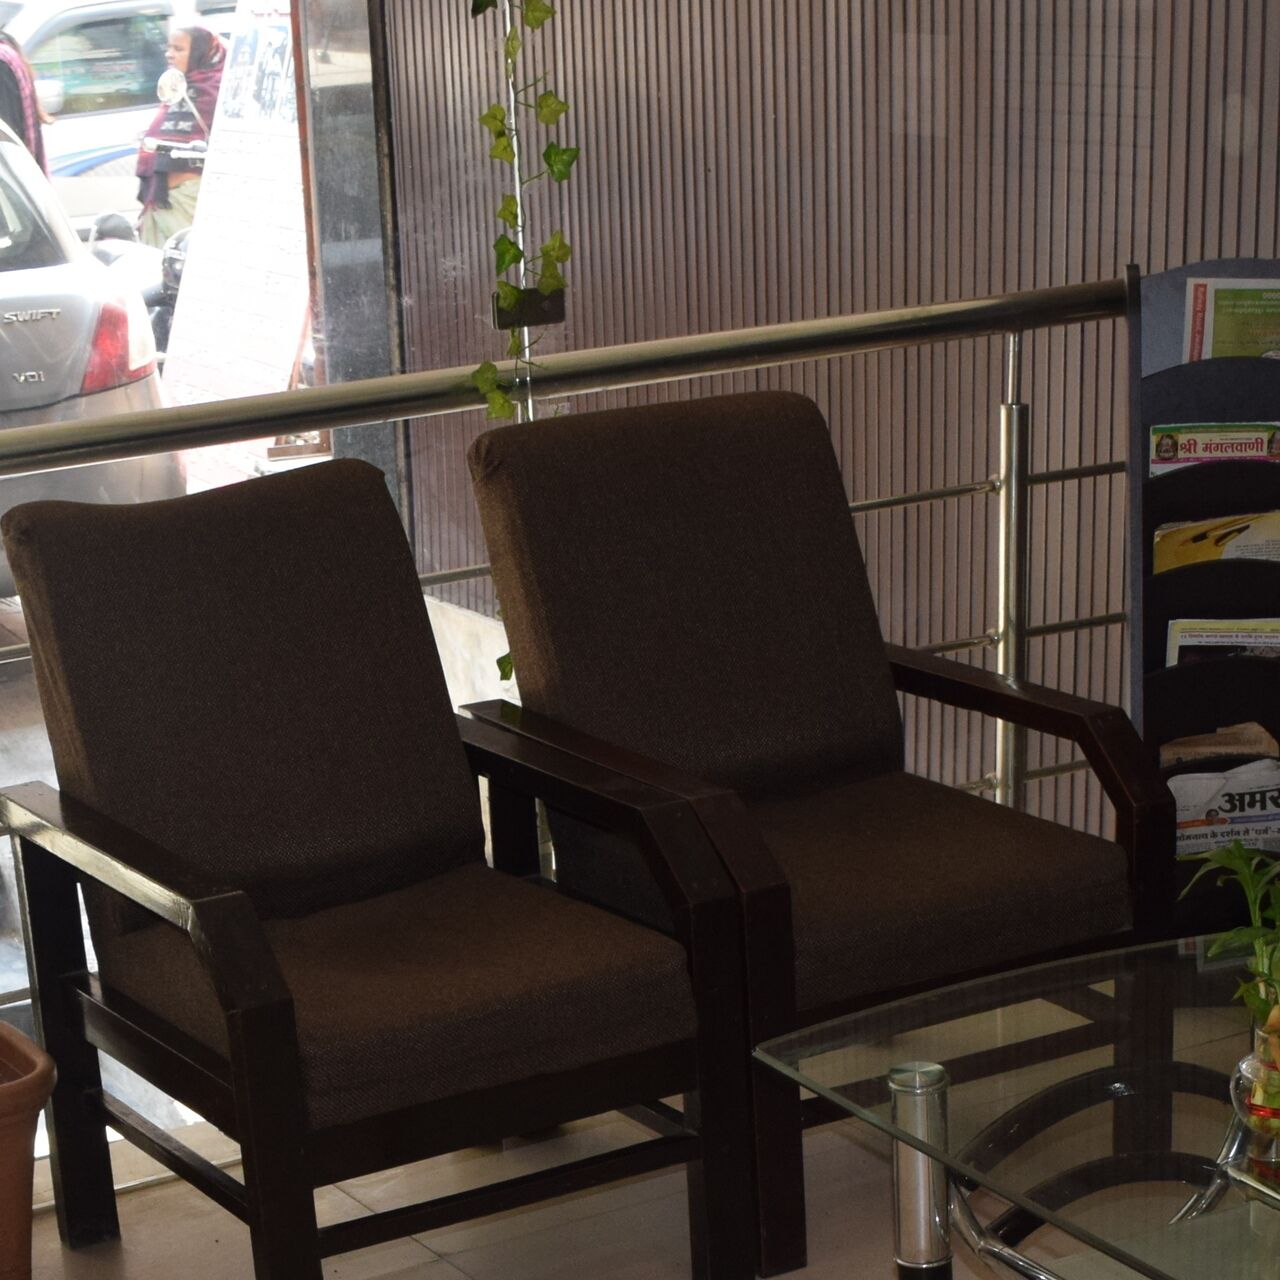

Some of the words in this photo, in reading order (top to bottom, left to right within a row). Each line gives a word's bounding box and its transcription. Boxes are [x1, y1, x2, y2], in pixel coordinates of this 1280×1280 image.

[3, 308, 61, 323] SWIFT
[1179, 438, 1198, 454] श्री
[1201, 437, 1264, 454] मंगलवाणी
